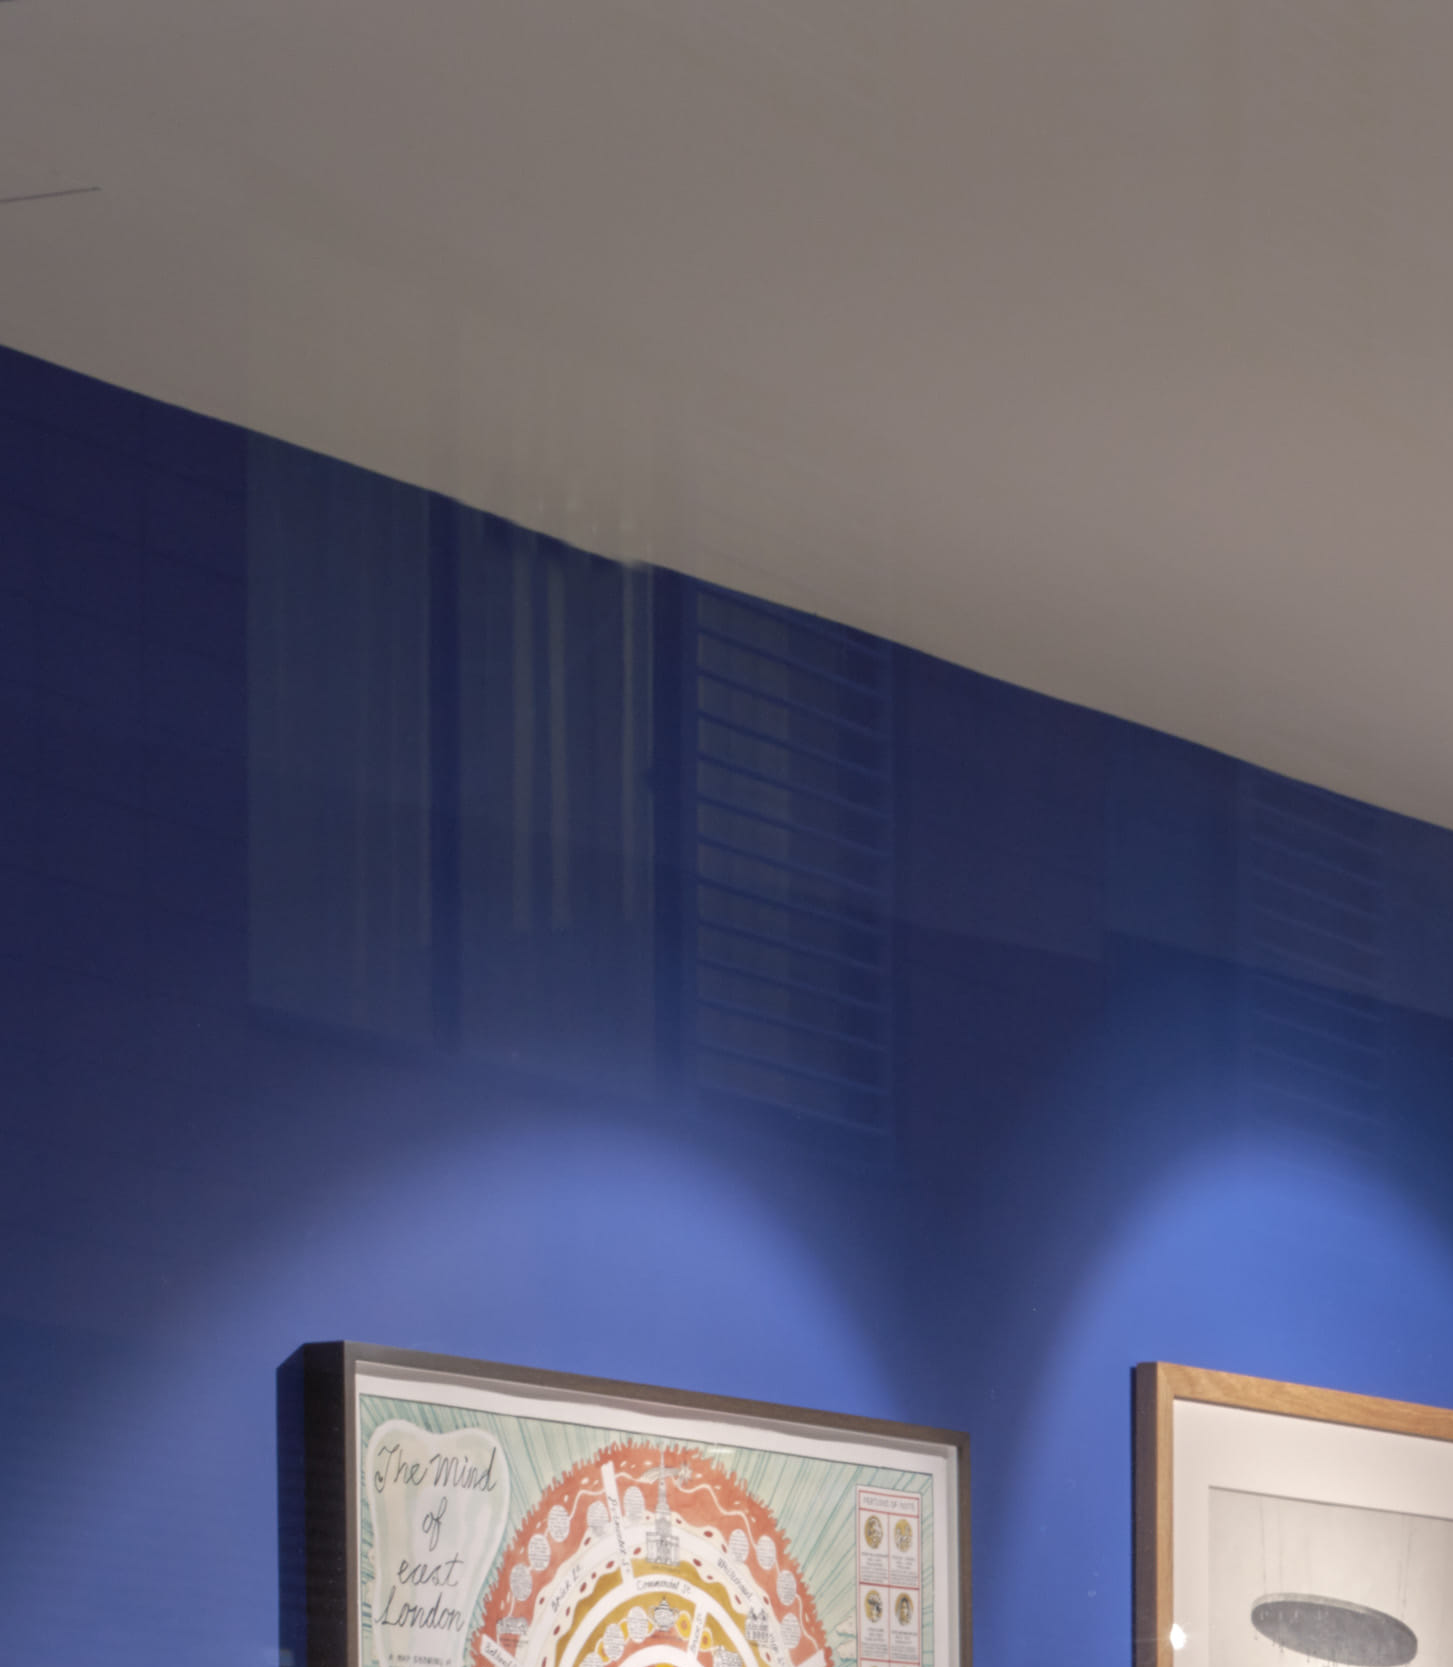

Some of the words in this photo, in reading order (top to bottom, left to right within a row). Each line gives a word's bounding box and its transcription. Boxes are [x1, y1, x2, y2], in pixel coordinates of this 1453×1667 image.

[375, 1444, 426, 1492] The
[429, 1446, 497, 1492] Mind
[422, 1497, 448, 1550] of
[396, 1553, 464, 1587] east
[376, 1586, 466, 1632] London
